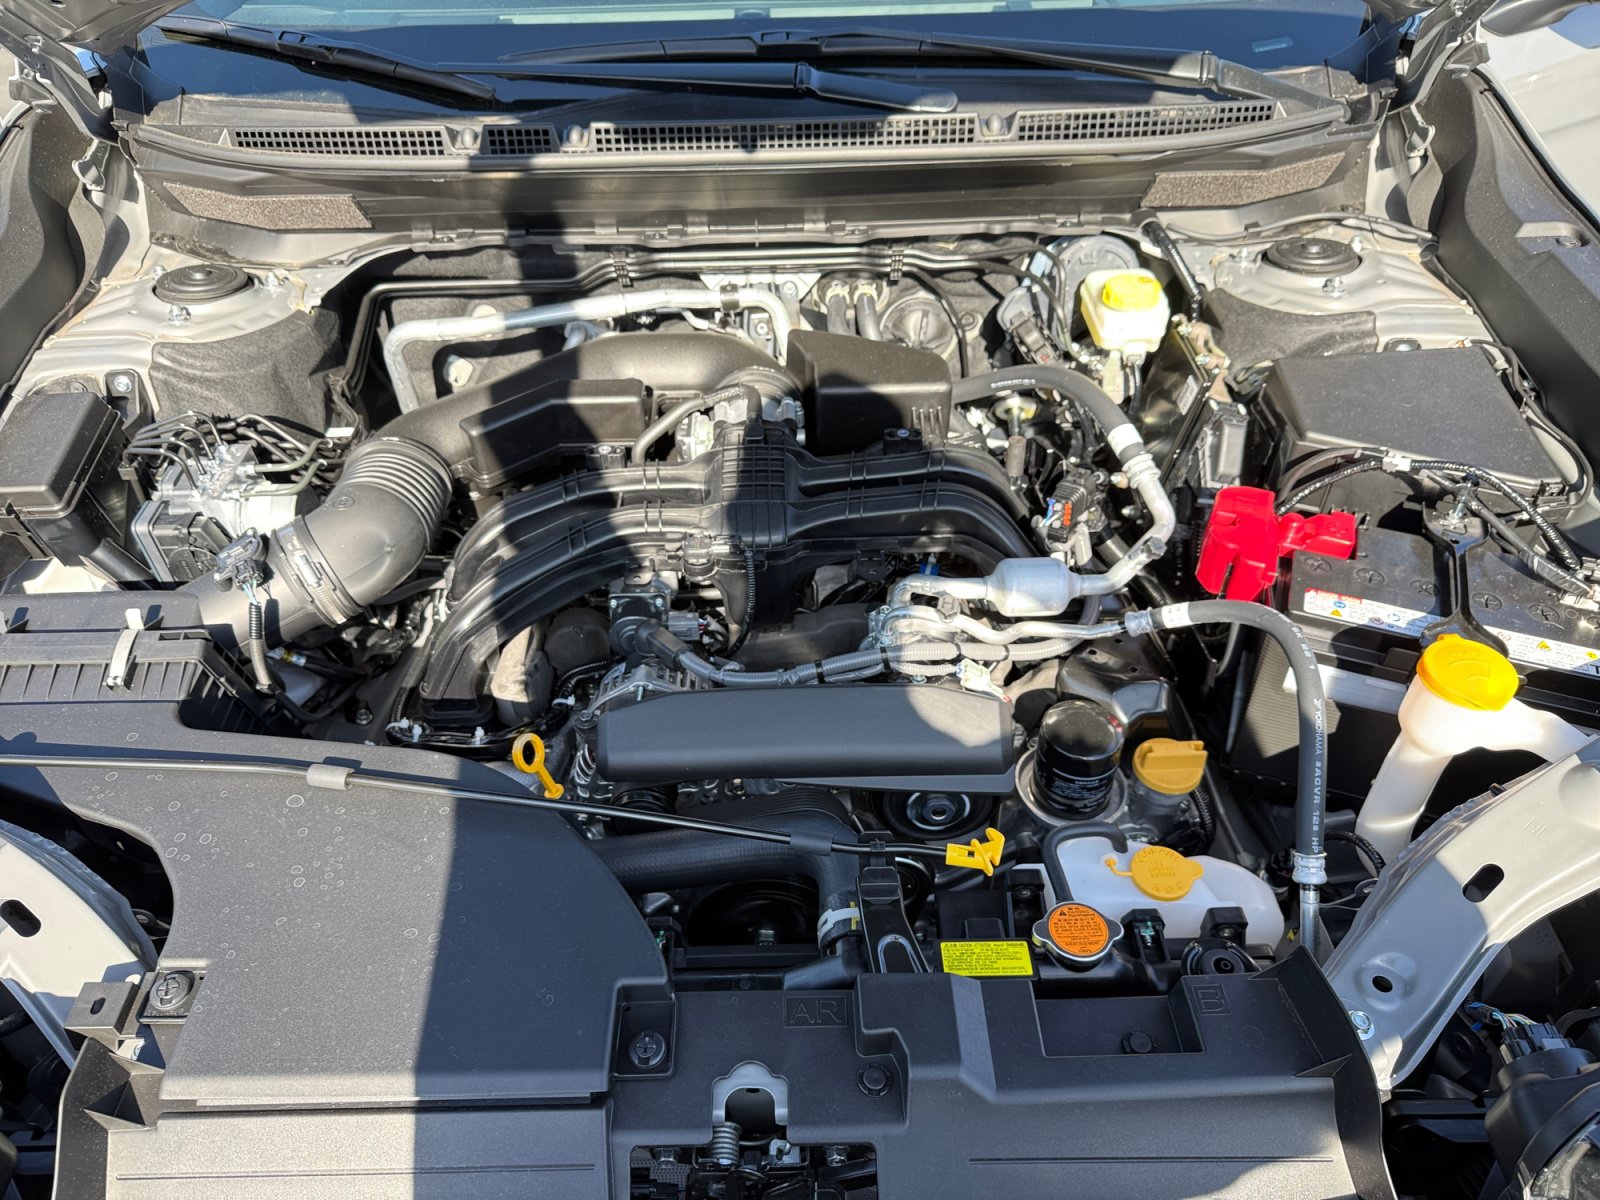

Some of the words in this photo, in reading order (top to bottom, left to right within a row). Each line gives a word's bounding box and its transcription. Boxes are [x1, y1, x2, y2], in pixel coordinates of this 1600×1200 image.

[1314, 710, 1324, 755] YOKOHAMA
[789, 999, 843, 1024] AR
[1197, 989, 1225, 1012] B
